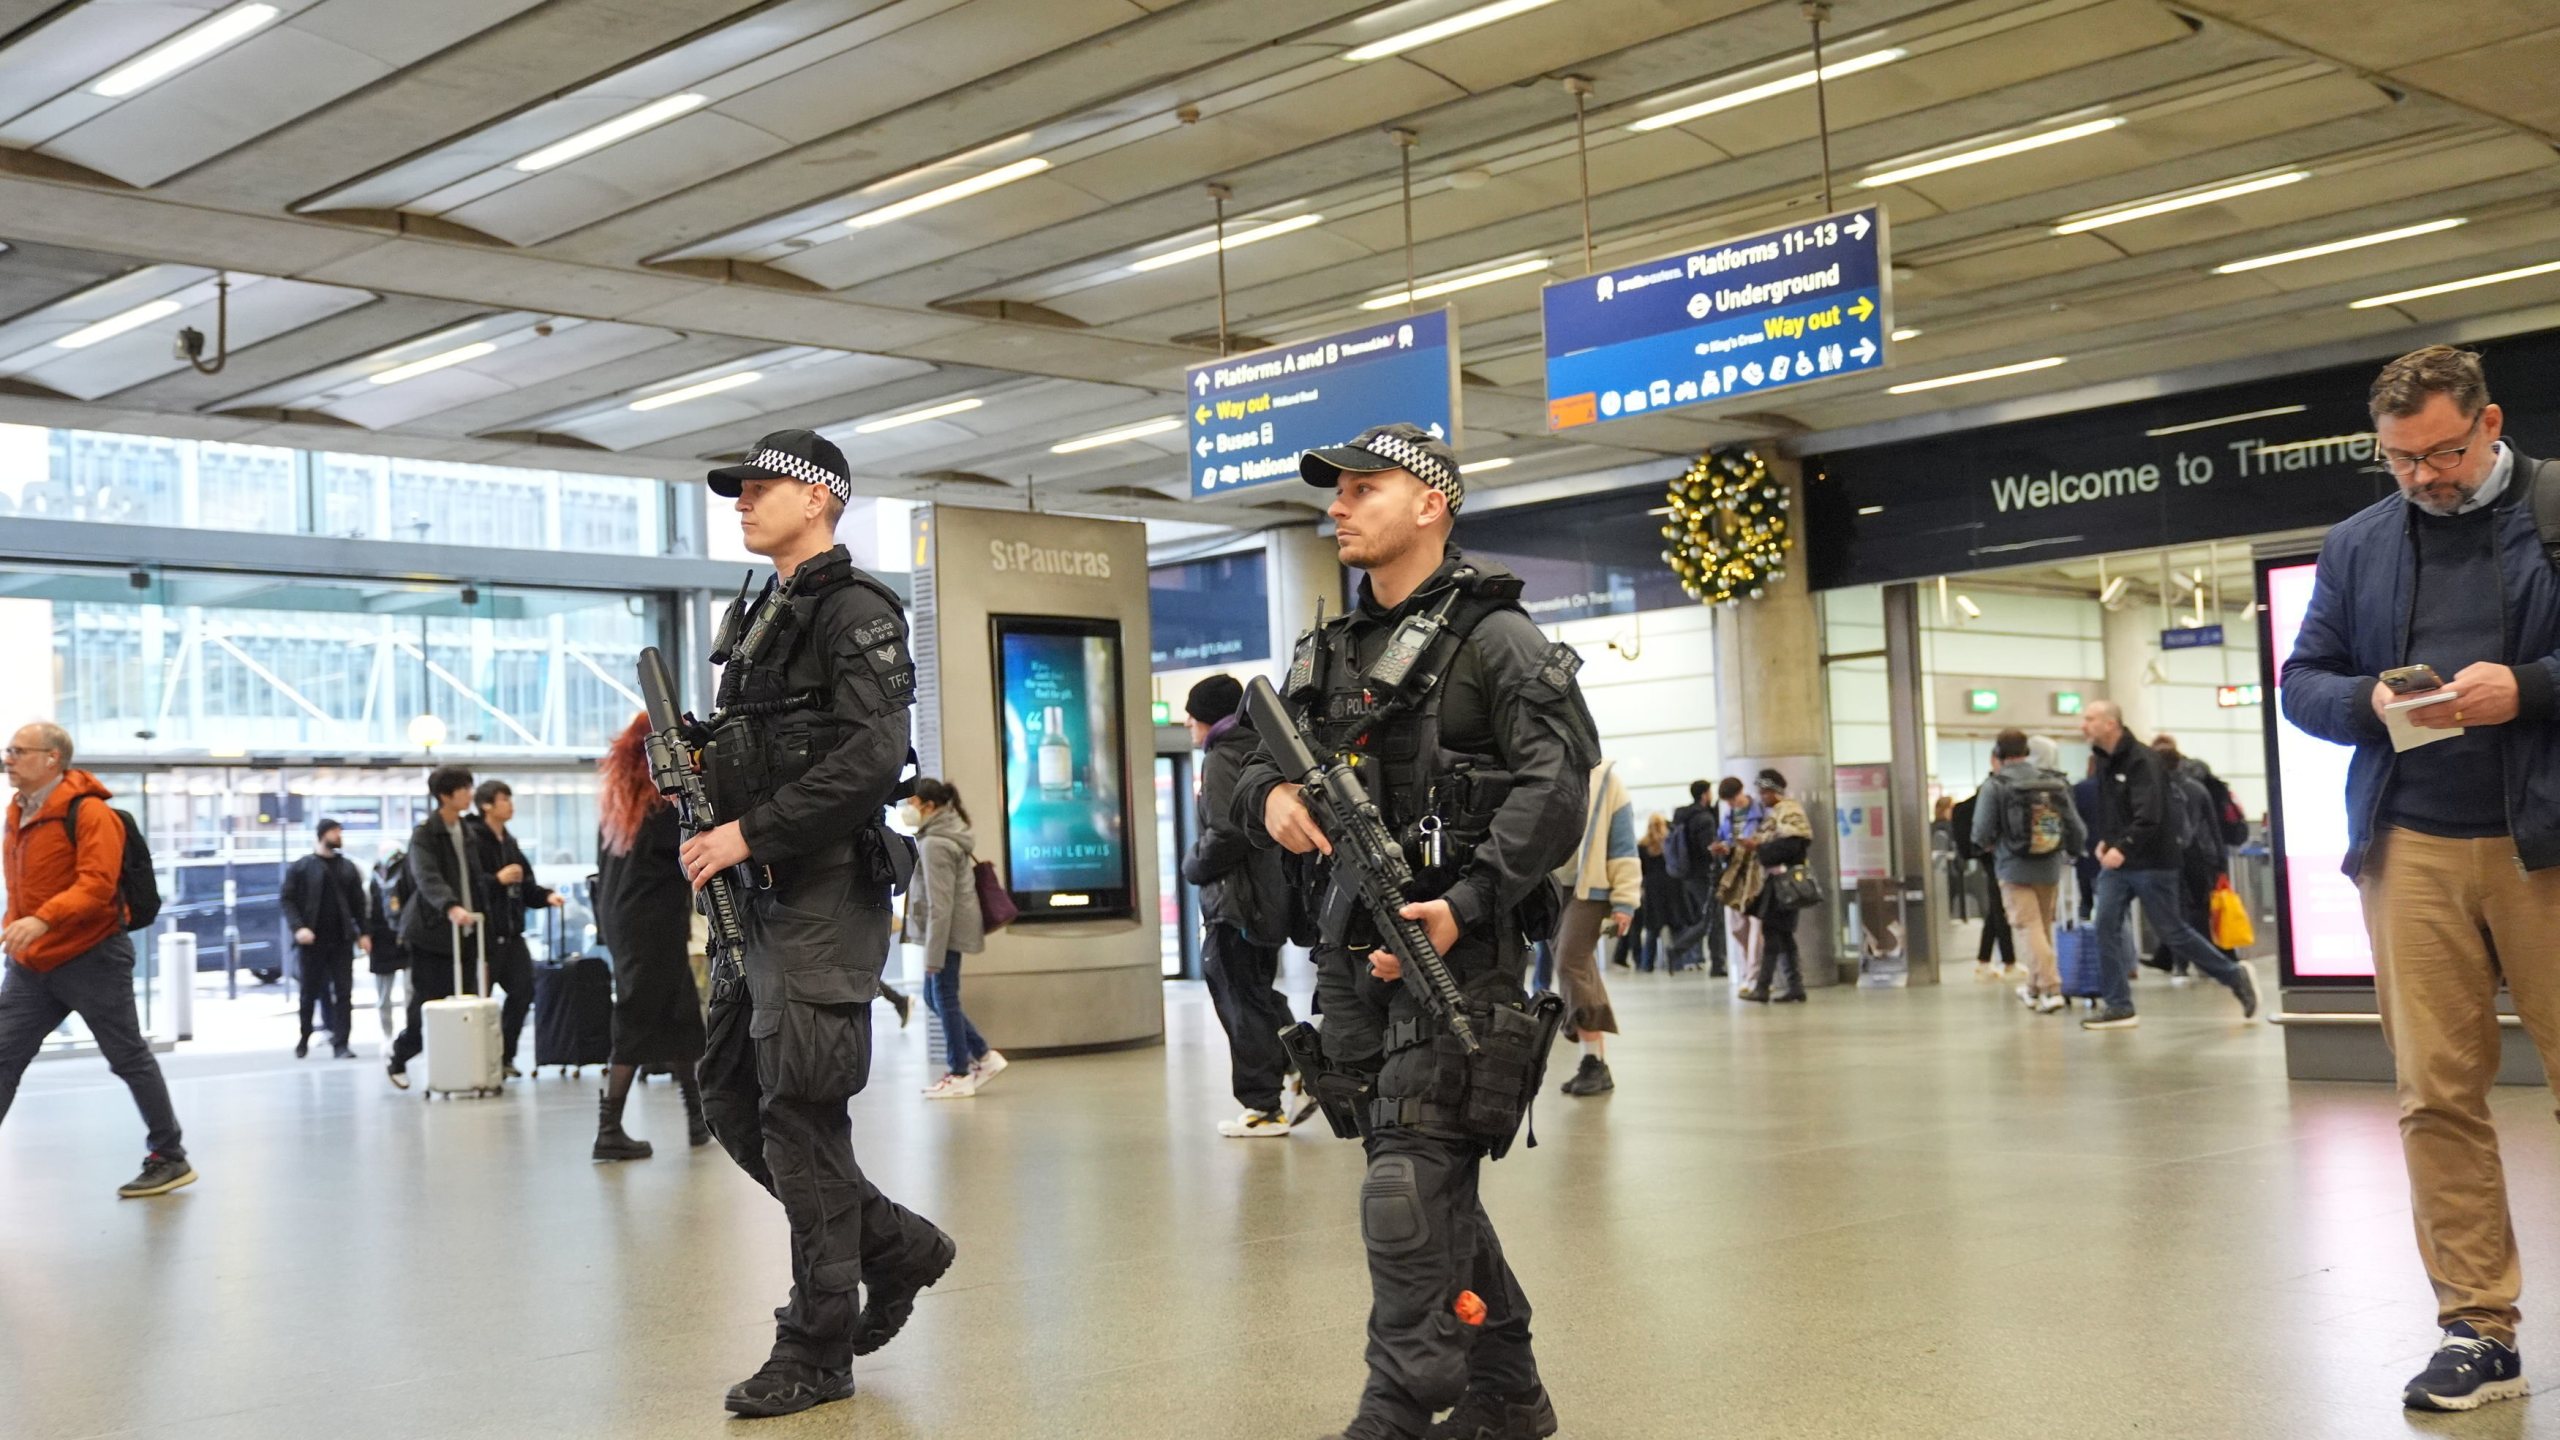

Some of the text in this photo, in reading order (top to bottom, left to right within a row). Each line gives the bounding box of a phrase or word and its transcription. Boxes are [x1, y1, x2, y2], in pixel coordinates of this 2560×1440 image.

[1687, 242, 1779, 279] Platforms
[1782, 222, 1838, 256] 11-13
[1715, 263, 1840, 312] Underground
[1764, 315, 1806, 341] Way
[1807, 304, 1842, 332] out
[1215, 360, 1282, 389] Platforms
[1283, 353, 1297, 375] A
[1296, 346, 1325, 371] and
[1325, 342, 1339, 365] B
[1216, 401, 1246, 420] Way
[1247, 393, 1270, 413] out
[1216, 430, 1260, 454] Buses
[1242, 451, 1299, 481] National
[1991, 463, 2162, 514] Welcome
[2175, 451, 2215, 487] to
[870, 622, 894, 634] POLICE
[888, 672, 909, 688] TFC
[1024, 844, 1110, 861] JOHN LEWIS
